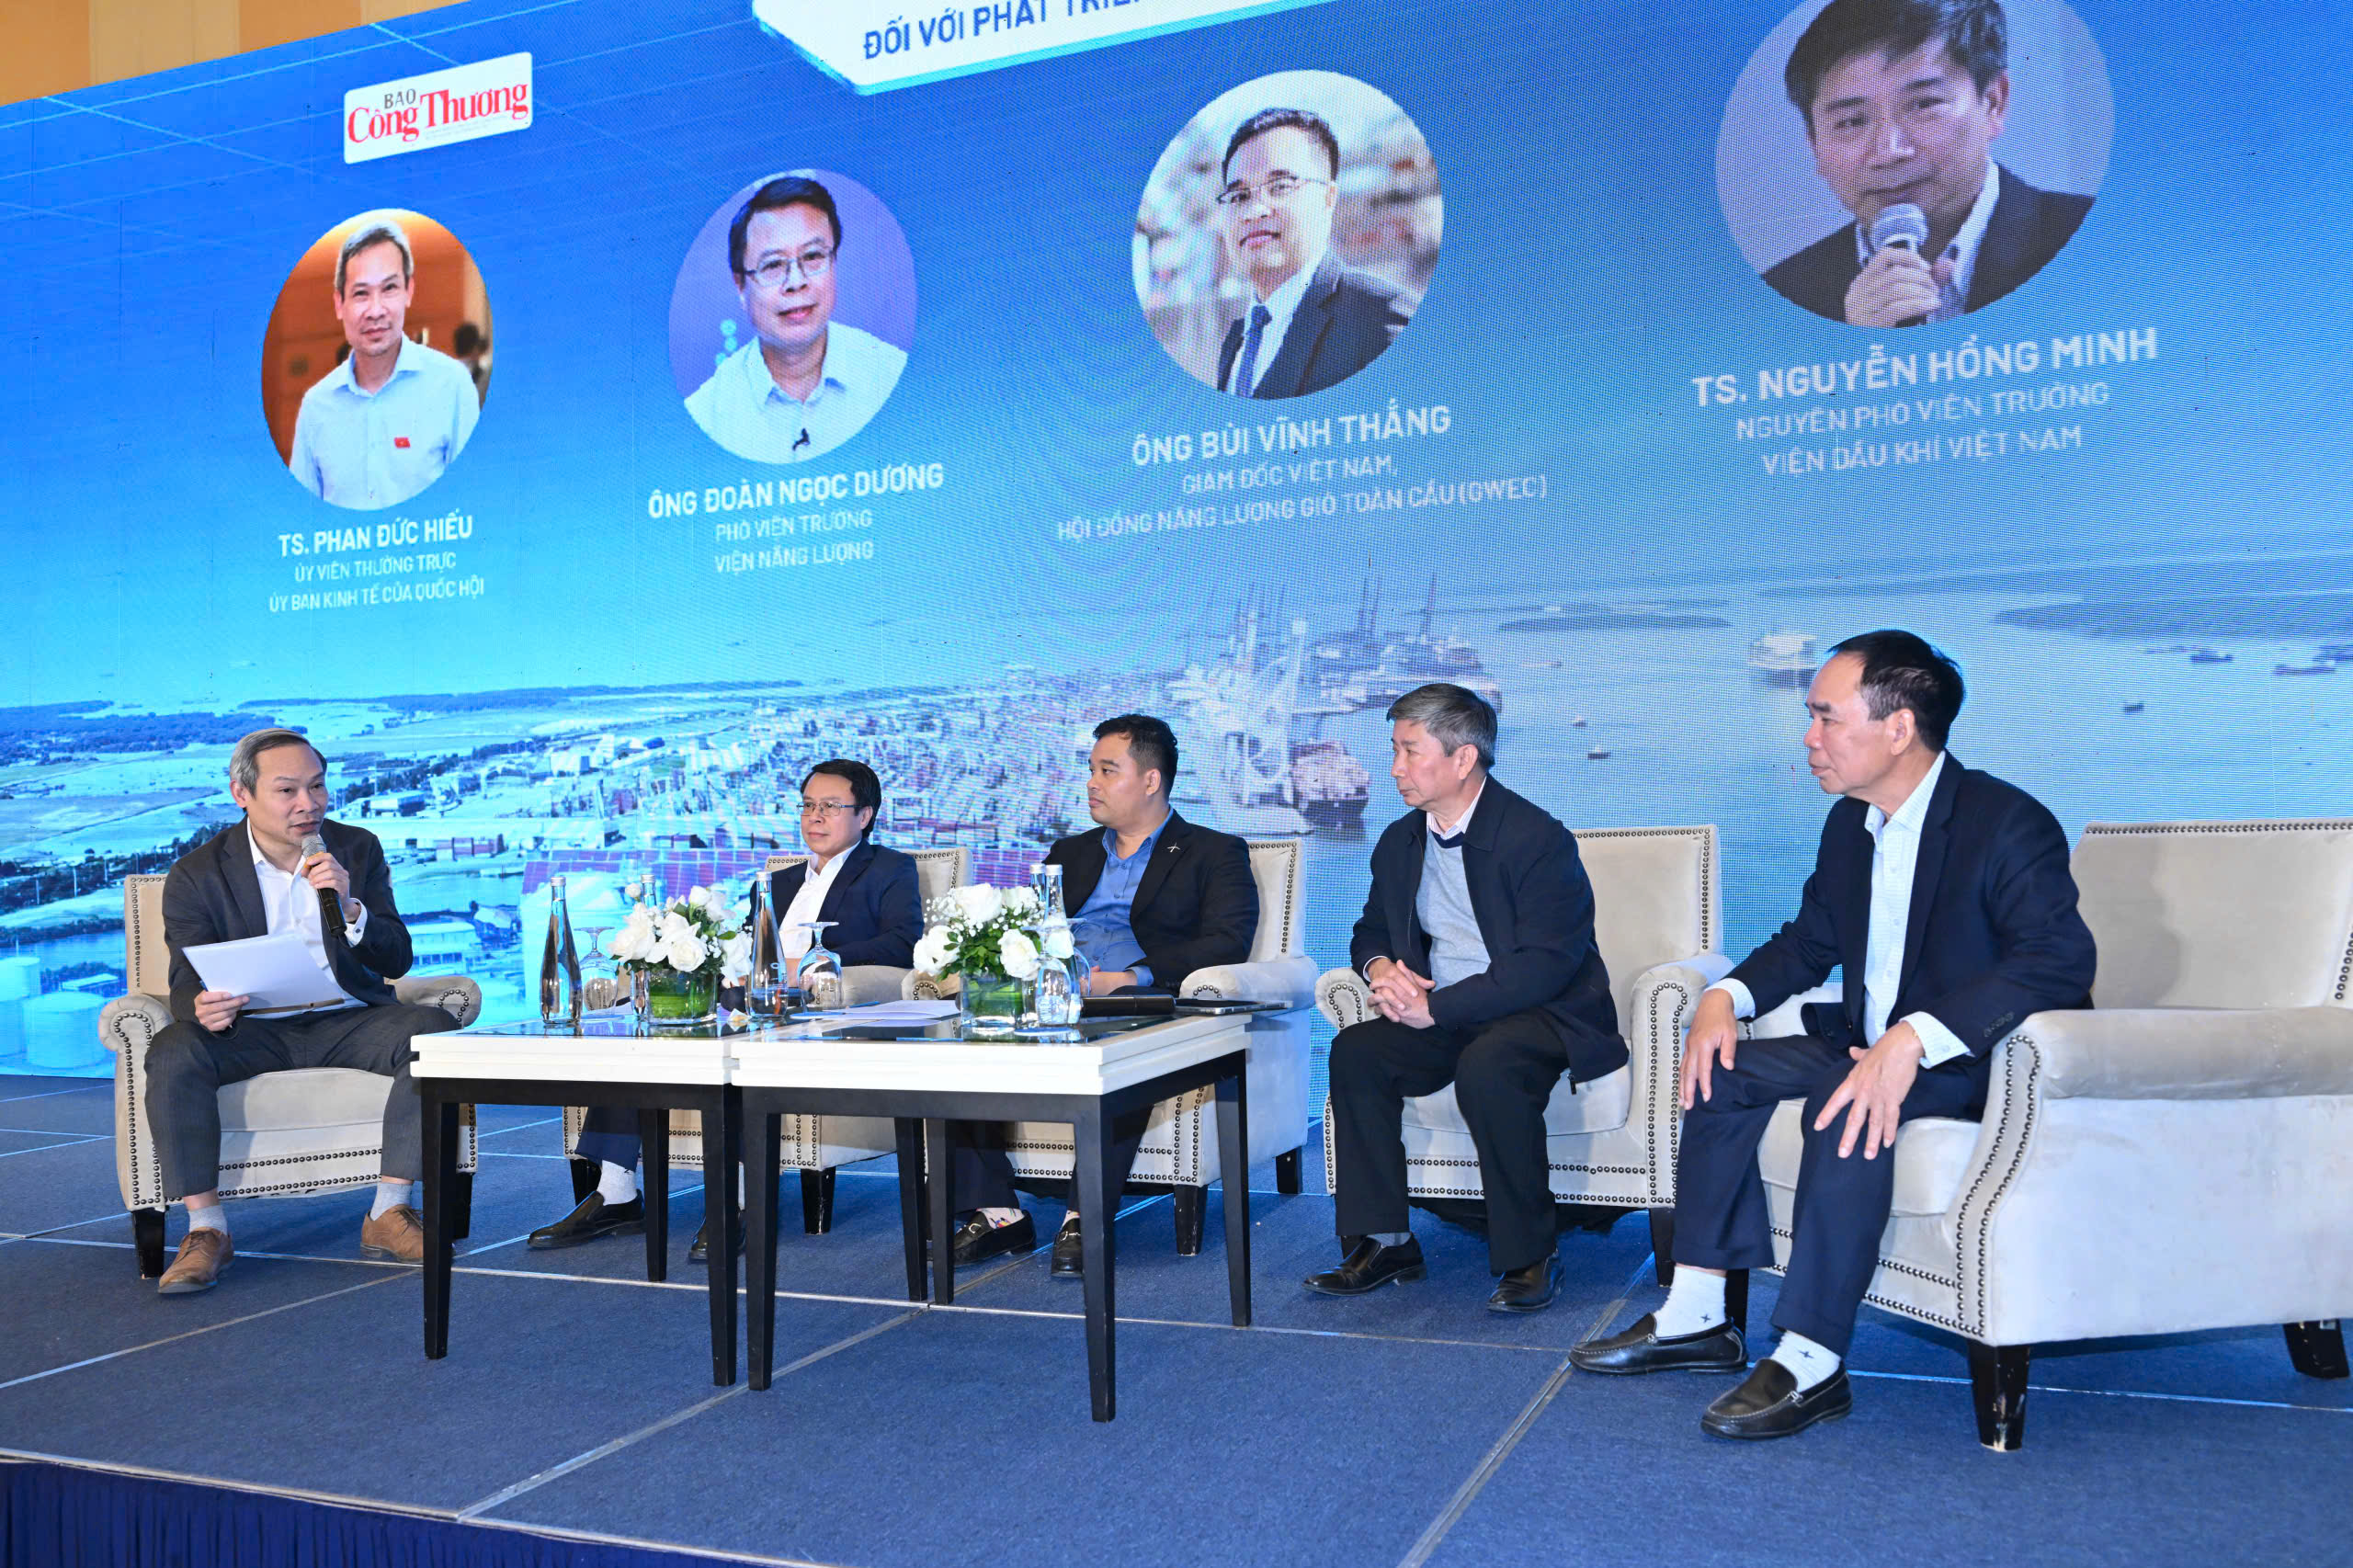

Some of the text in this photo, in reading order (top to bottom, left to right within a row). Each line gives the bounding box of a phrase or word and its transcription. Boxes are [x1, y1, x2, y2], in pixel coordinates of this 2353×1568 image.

[863, 16, 910, 60] ĐỐI
[918, 7, 964, 47] VỚI
[347, 106, 420, 143] Công
[420, 84, 529, 129] Thương
[1692, 373, 1748, 407] TS.
[1757, 344, 1918, 401] NGUYỄN
[2051, 326, 2159, 369] MINH
[1131, 432, 1193, 467] ÔNG
[1256, 415, 1331, 453] VĨNH
[1735, 405, 1847, 440] NGUYÊN
[2018, 425, 2084, 452] NAM
[648, 462, 945, 518] ÔNG ĐOÀN NGỌC DƯƠNG
[278, 508, 473, 558] TS. PHAN ĐỨC HIẾU
[291, 593, 321, 611] BAN
[323, 590, 358, 609] KINH
[459, 574, 485, 600] HỘI
